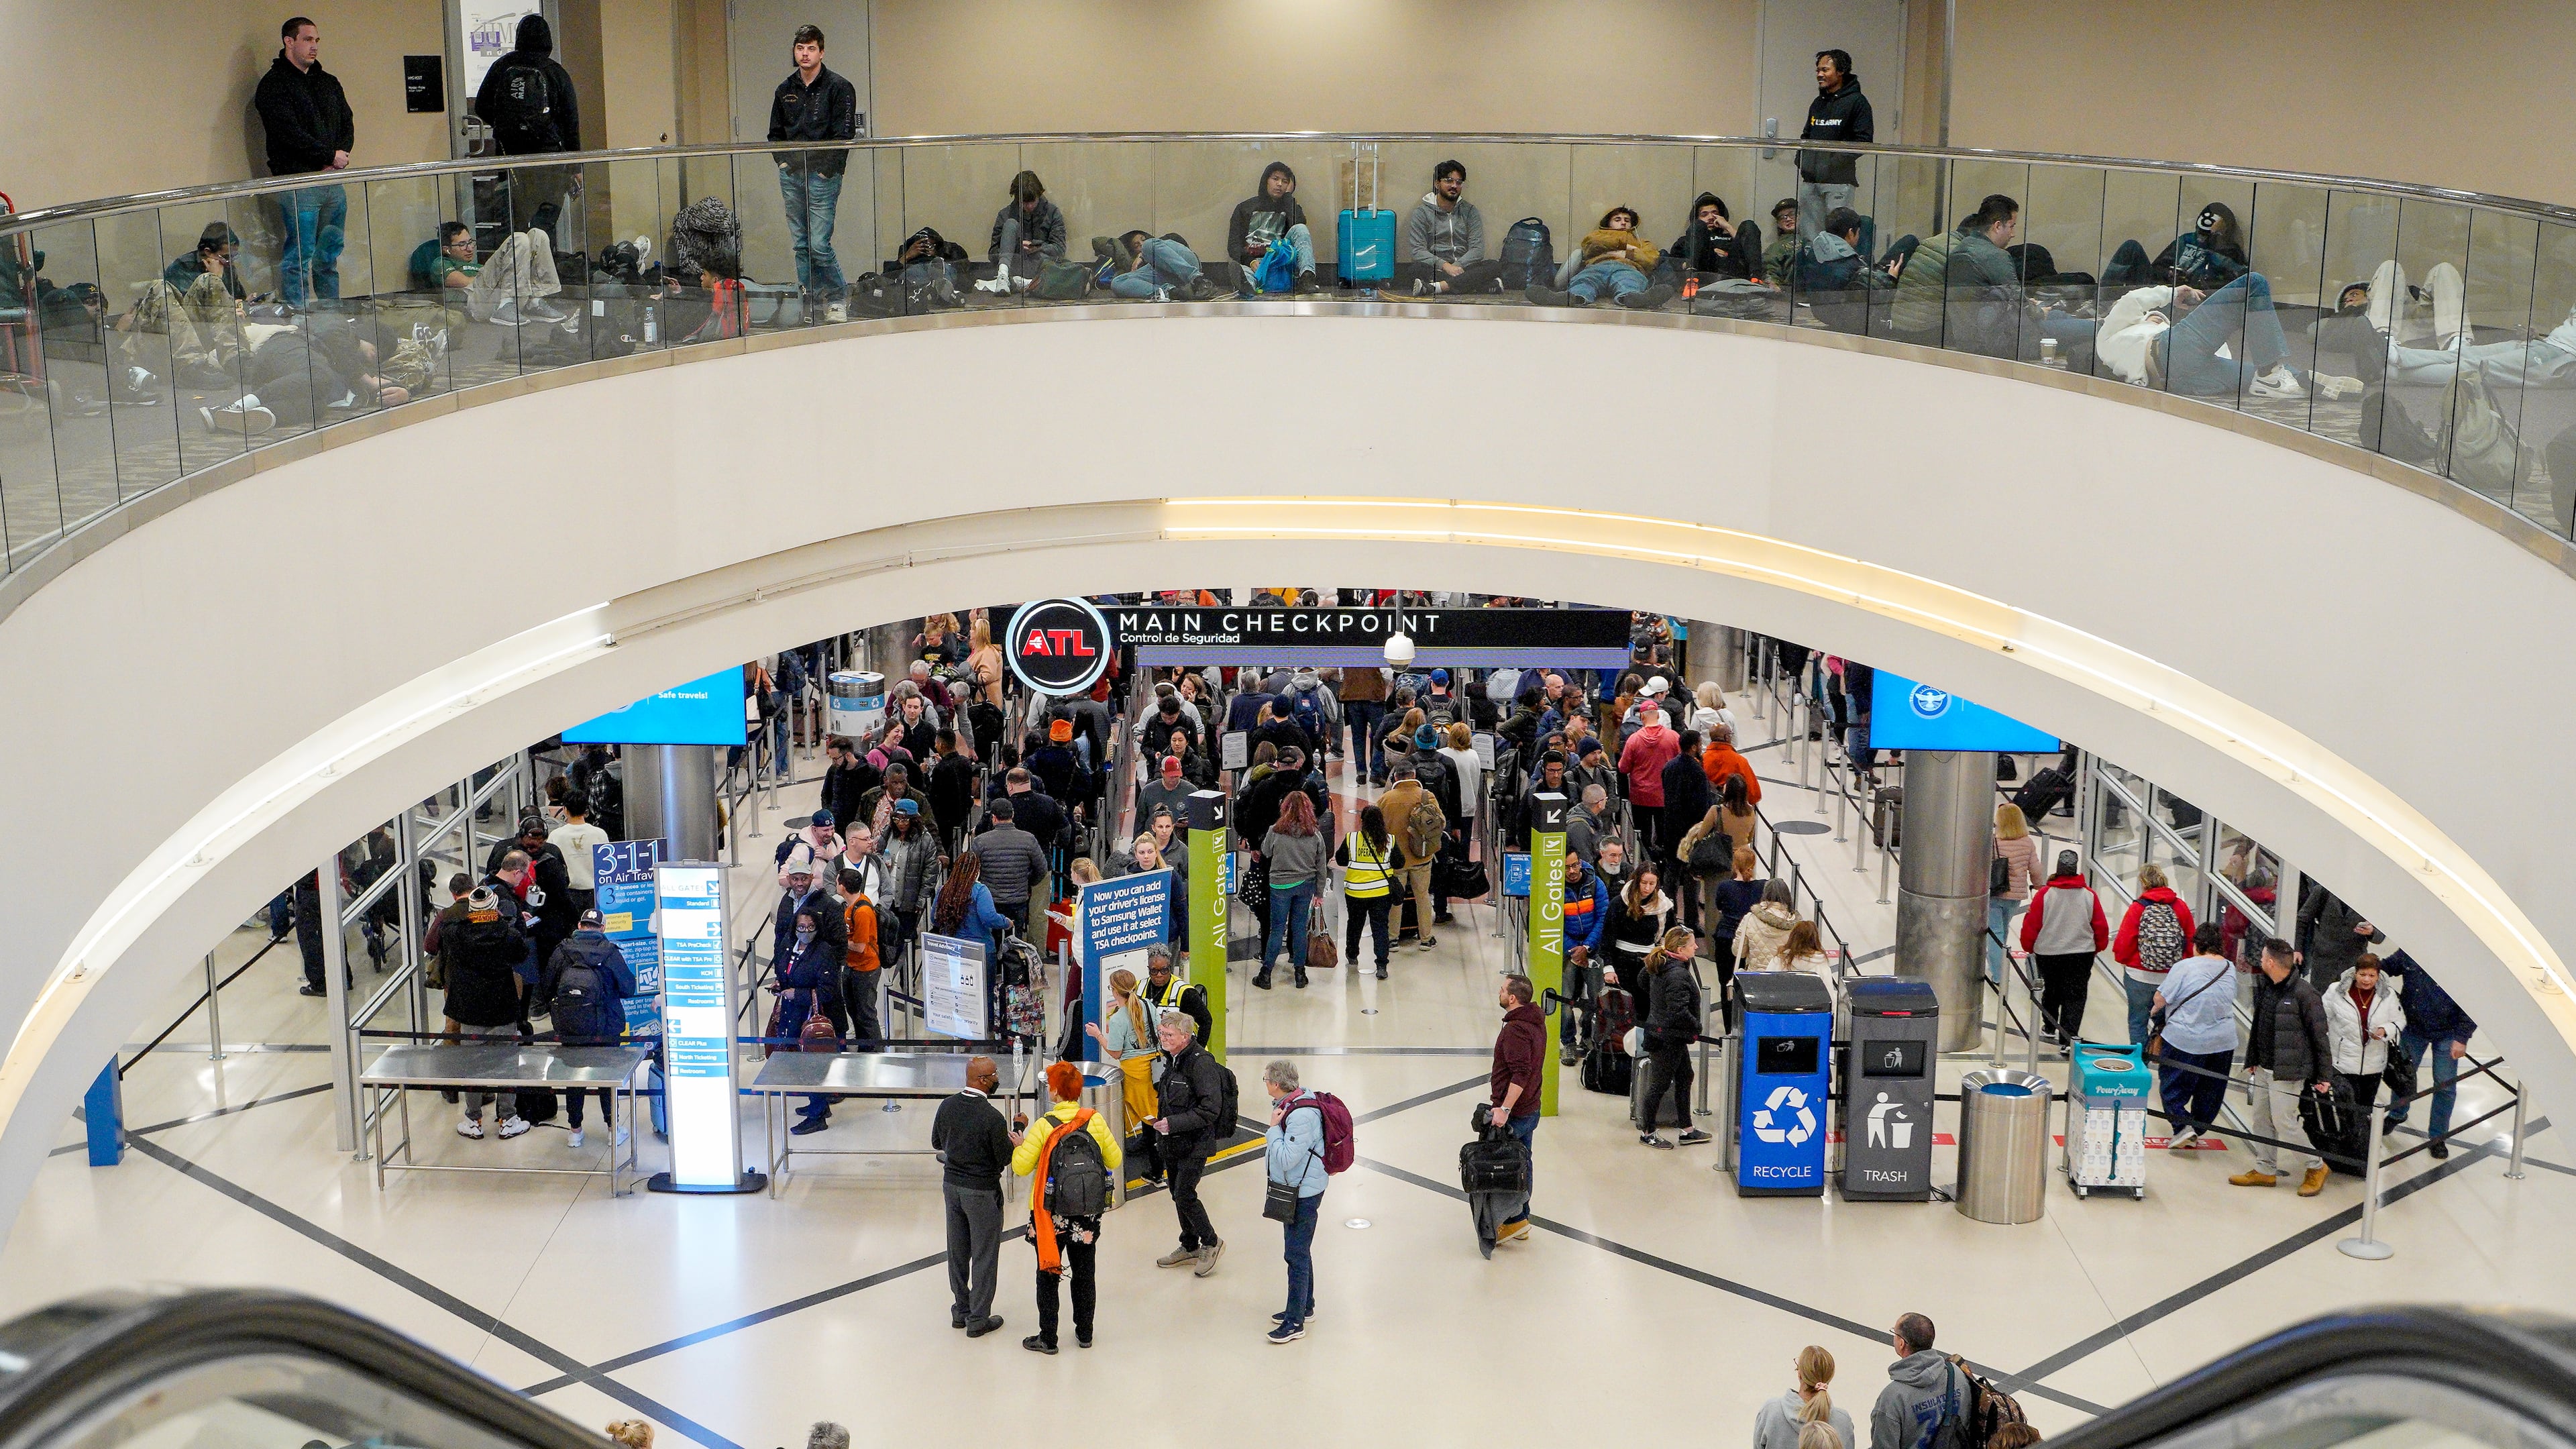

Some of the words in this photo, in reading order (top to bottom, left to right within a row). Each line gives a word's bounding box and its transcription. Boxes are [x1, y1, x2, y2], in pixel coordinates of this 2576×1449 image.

[1120, 613, 1201, 631] MAIN
[1222, 614, 1440, 633] CHECKPOINT
[1022, 629, 1095, 656] ATL
[1120, 633, 1162, 643] Control
[1165, 633, 1179, 643] de
[1182, 633, 1240, 645] Seguridad
[658, 691, 676, 699] Safe
[678, 691, 708, 700] travels!
[597, 839, 659, 875] 3-1-1
[598, 875, 612, 884] on
[615, 873, 630, 883] Air
[632, 871, 654, 881] Trav
[1214, 853, 1226, 916] Gates
[1094, 891, 1114, 902] Now
[1114, 888, 1130, 898] you
[1131, 885, 1144, 895] can
[1146, 880, 1161, 891] add
[1542, 859, 1563, 921] Gates
[1089, 904, 1107, 917] your
[1108, 898, 1138, 911] driver's
[1140, 892, 1166, 905] license
[1091, 918, 1100, 927] to
[1101, 910, 1137, 924] Samsung
[1138, 904, 1163, 917] Wallet
[1091, 928, 1106, 939] and
[1108, 925, 1121, 934] use
[1122, 922, 1129, 932] it
[1130, 922, 1138, 930] at
[1139, 916, 1162, 928] select
[1213, 922, 1226, 949] All
[1094, 940, 1110, 951] TSA
[1111, 929, 1159, 947] checkpoints.
[1540, 928, 1561, 955] All
[1754, 1166, 1812, 1177] RECYCLE
[1864, 1170, 1907, 1182] TRASH
